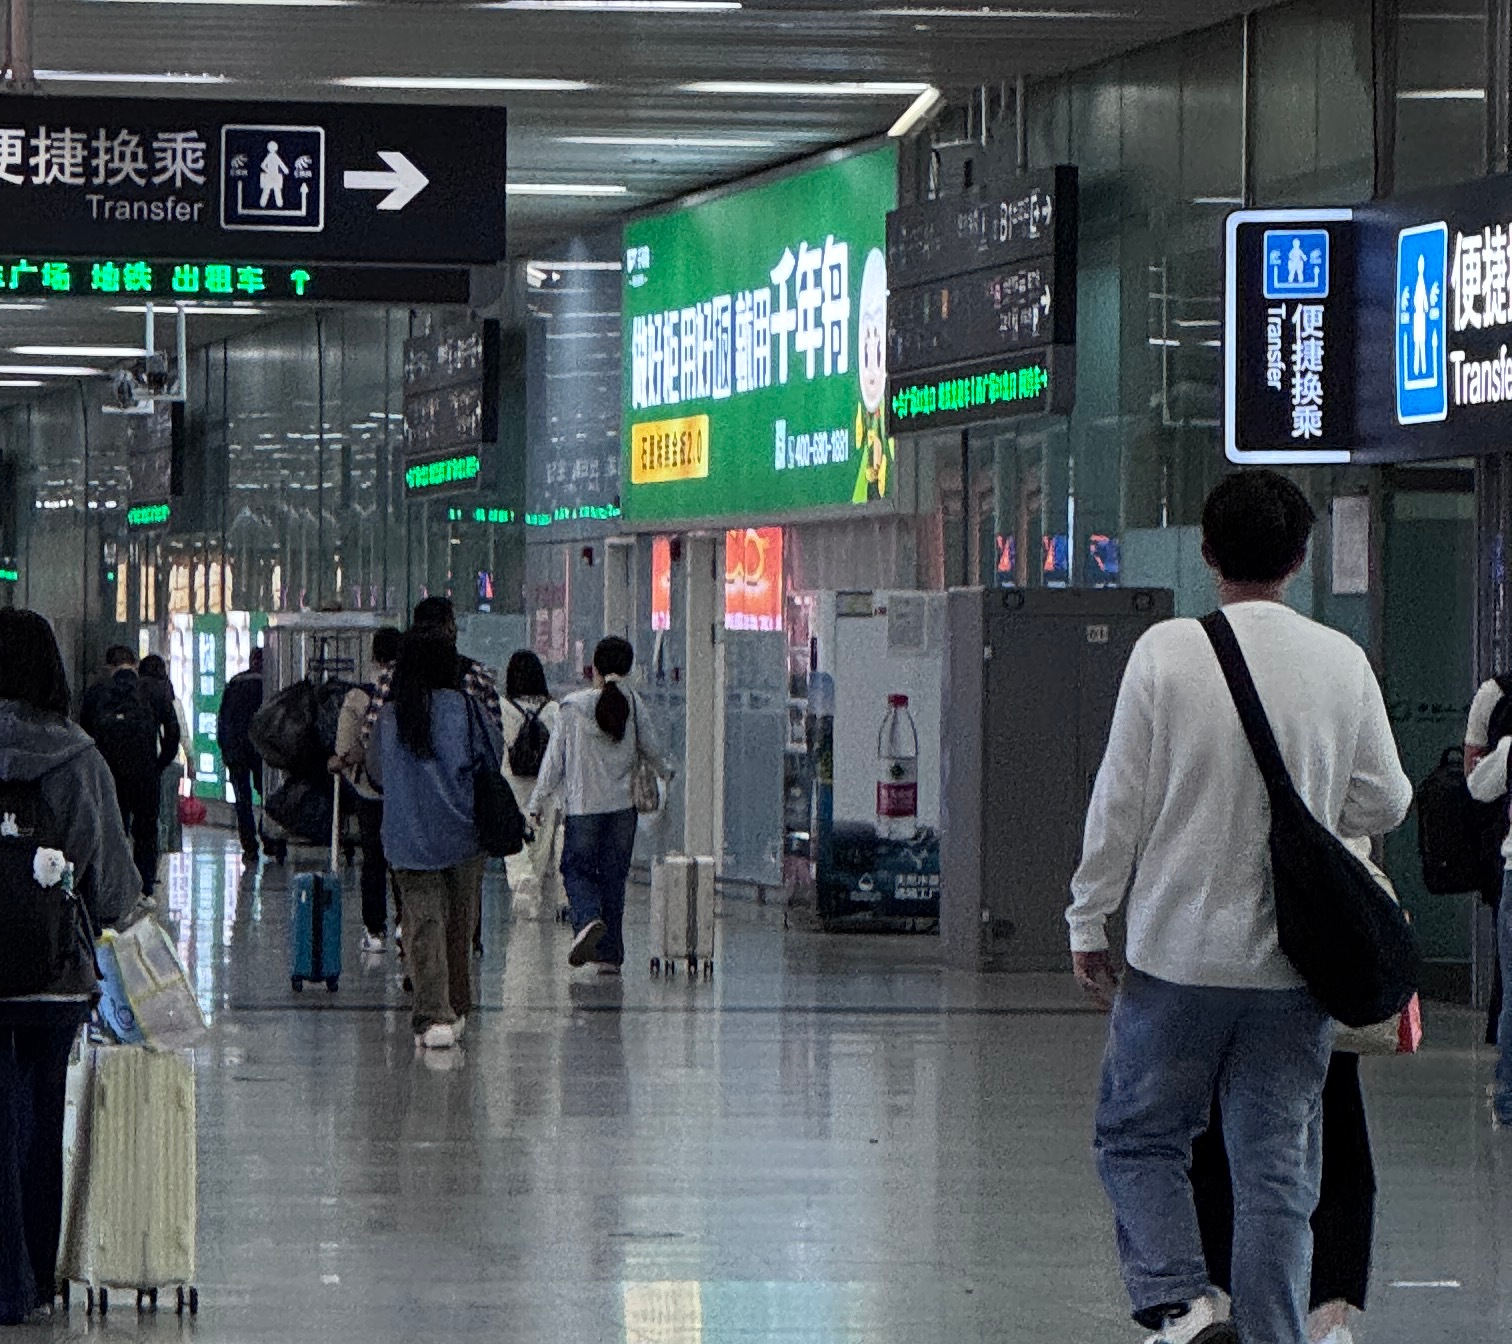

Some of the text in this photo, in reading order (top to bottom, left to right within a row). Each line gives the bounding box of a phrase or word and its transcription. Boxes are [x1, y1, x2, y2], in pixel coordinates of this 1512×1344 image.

[85, 194, 206, 223] Transfer
[91, 261, 153, 293] 地铁
[173, 264, 265, 294] 出租车
[1450, 224, 1512, 332] 便捷
[1267, 302, 1286, 391] Transfer
[1290, 302, 1326, 440] 便捷换乘
